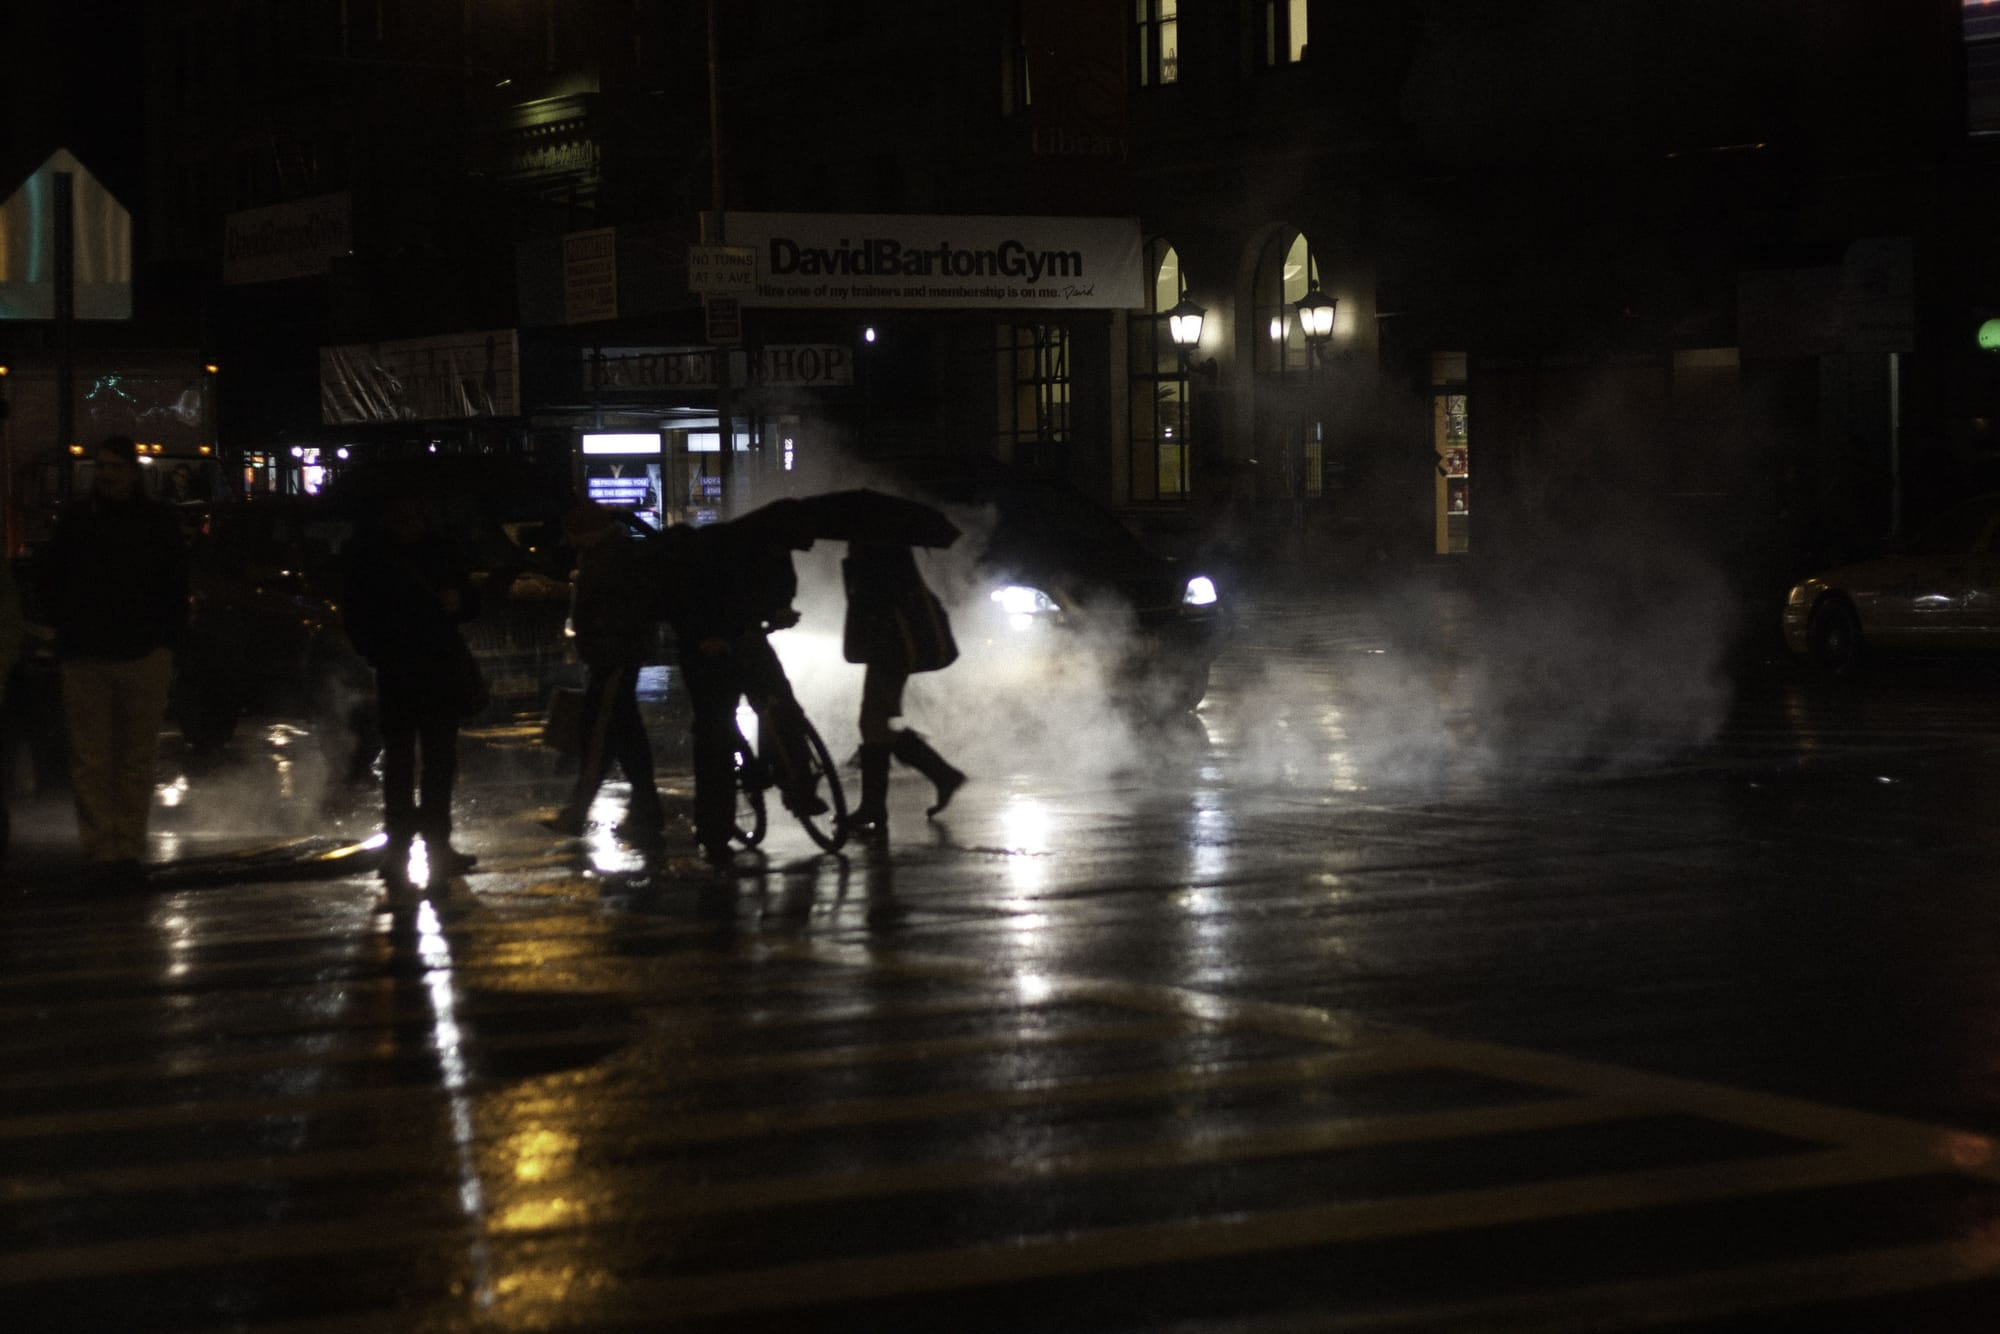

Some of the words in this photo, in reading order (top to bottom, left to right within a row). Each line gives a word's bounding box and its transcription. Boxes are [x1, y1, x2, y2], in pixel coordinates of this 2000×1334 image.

[692, 254, 709, 265] NO
[715, 254, 753, 266] TURNS
[770, 238, 1083, 284] DavidBartonGym
[695, 272, 710, 283] AT
[728, 271, 752, 284] AVE
[757, 284, 784, 297] Hire
[787, 287, 809, 297] one
[814, 284, 827, 297] of
[830, 287, 850, 300] my
[852, 285, 900, 298] trainers
[903, 285, 926, 297] and
[929, 285, 1005, 300] membership
[1008, 286, 1017, 298] is
[1020, 288, 1036, 298] on
[1039, 288, 1060, 298] me.
